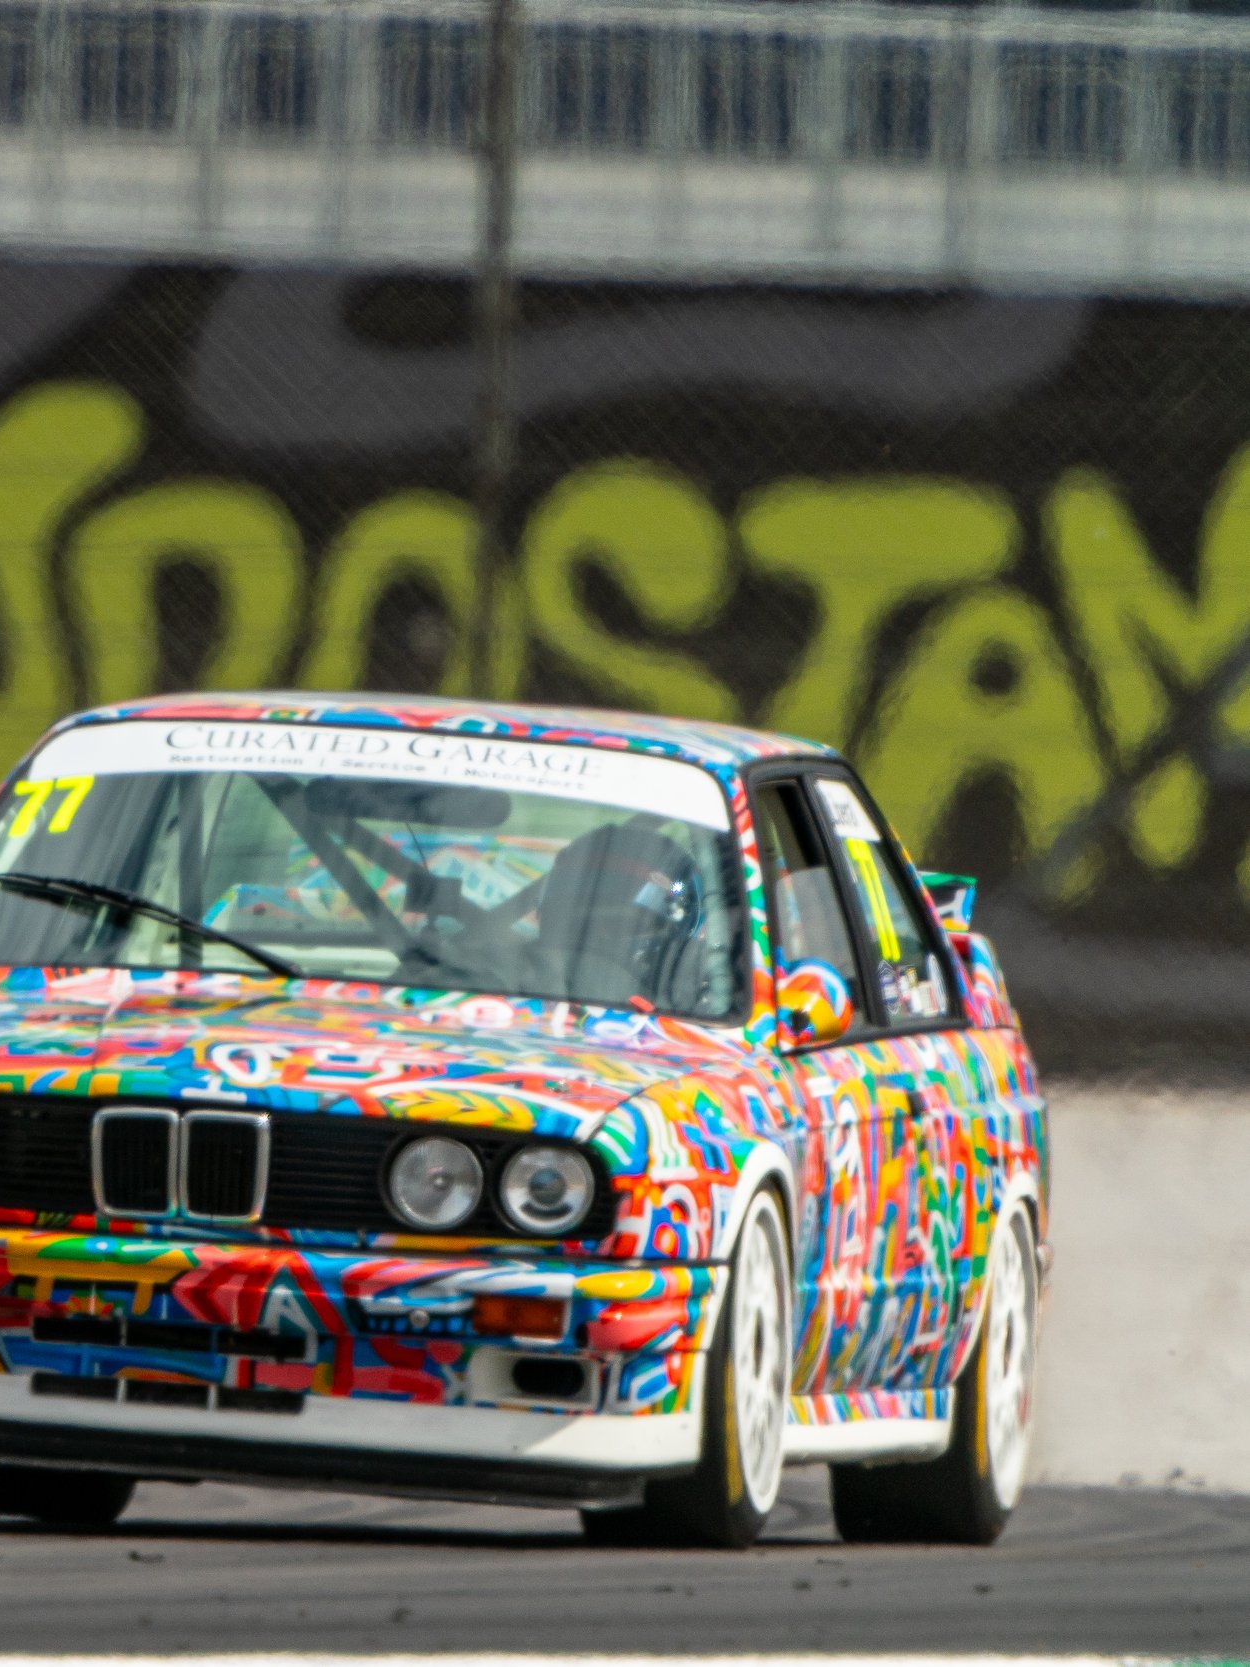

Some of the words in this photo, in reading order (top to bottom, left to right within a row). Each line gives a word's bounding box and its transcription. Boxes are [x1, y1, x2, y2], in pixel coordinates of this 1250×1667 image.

[165, 724, 391, 755] CURATED
[407, 733, 604, 779] GARAGE
[169, 753, 304, 767] Restoration
[341, 756, 427, 774] Service
[464, 766, 590, 792] Motorsport
[8, 774, 95, 838] 77
